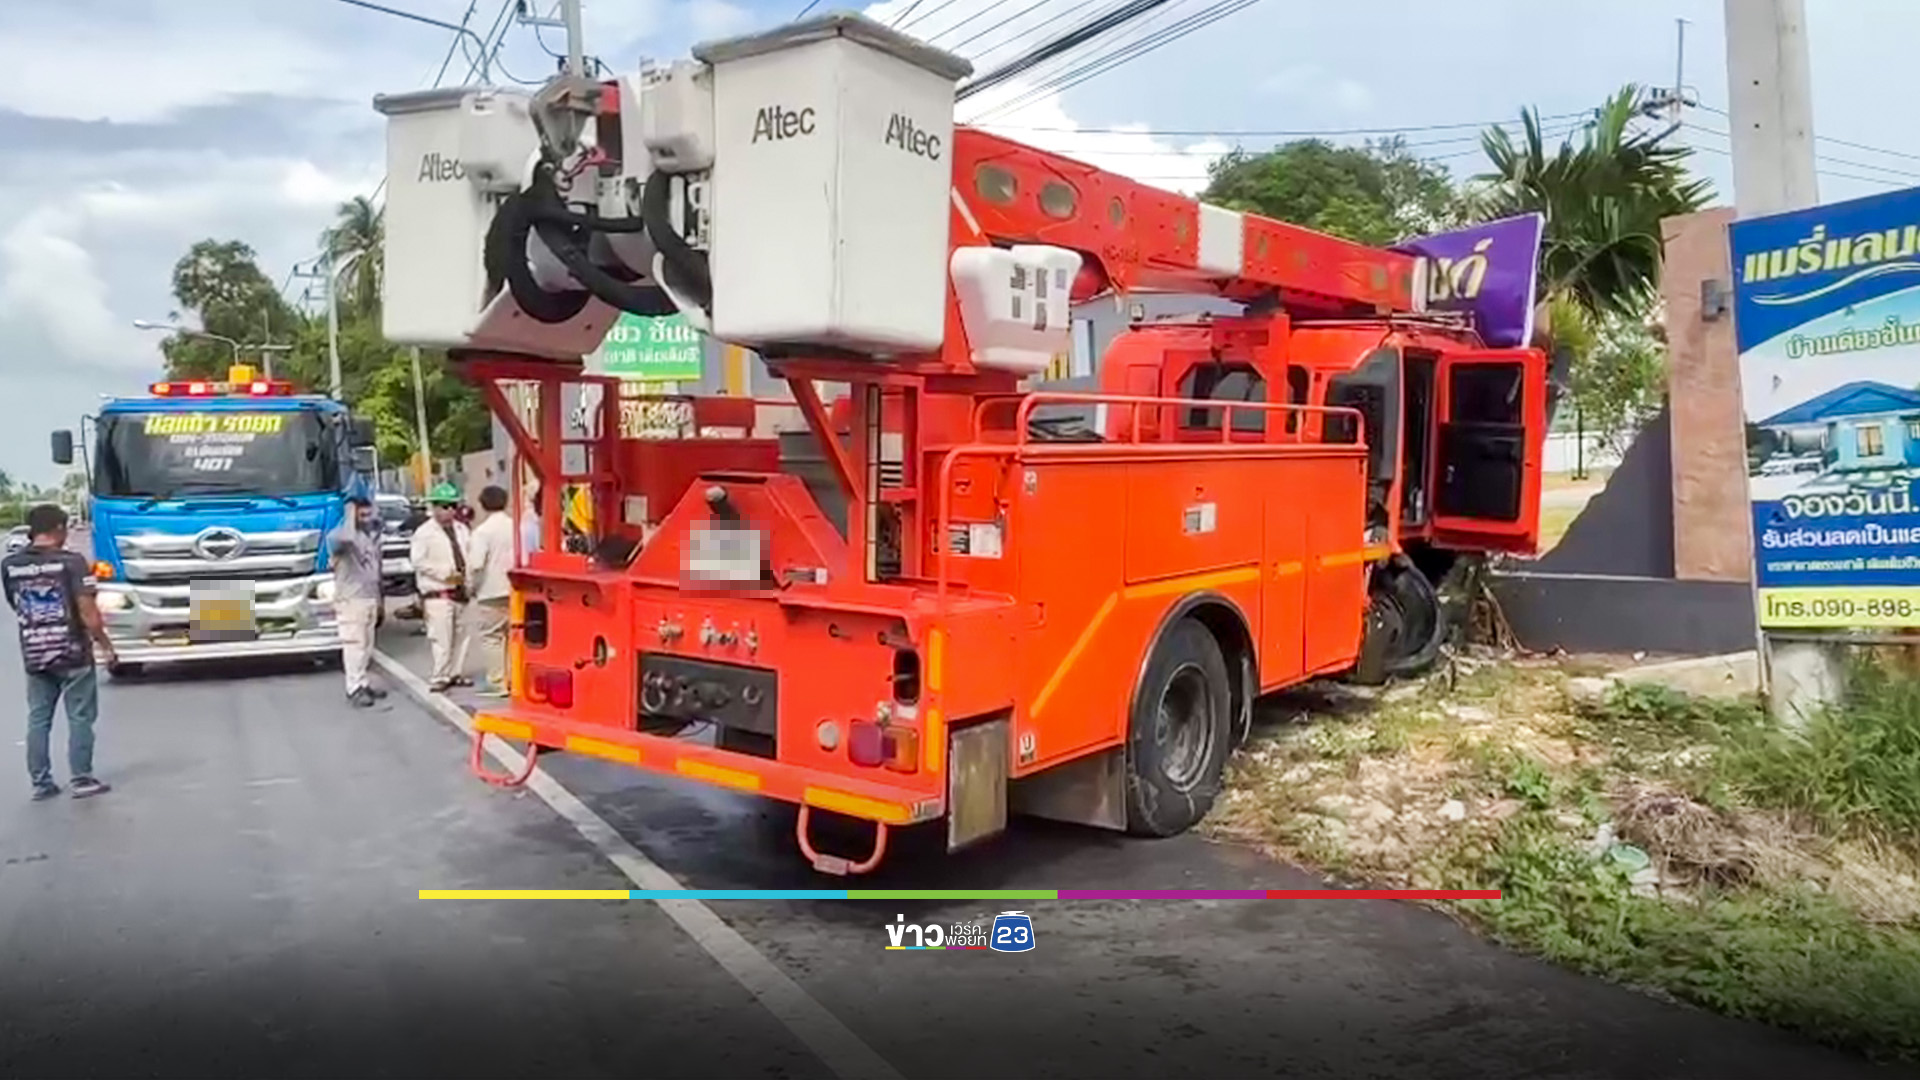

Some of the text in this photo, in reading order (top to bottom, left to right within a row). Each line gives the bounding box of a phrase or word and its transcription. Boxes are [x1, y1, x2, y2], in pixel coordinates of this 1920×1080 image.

[751, 105, 816, 144] Altec
[884, 113, 942, 161] Altec
[1743, 224, 1920, 284] แมรี่แลน
